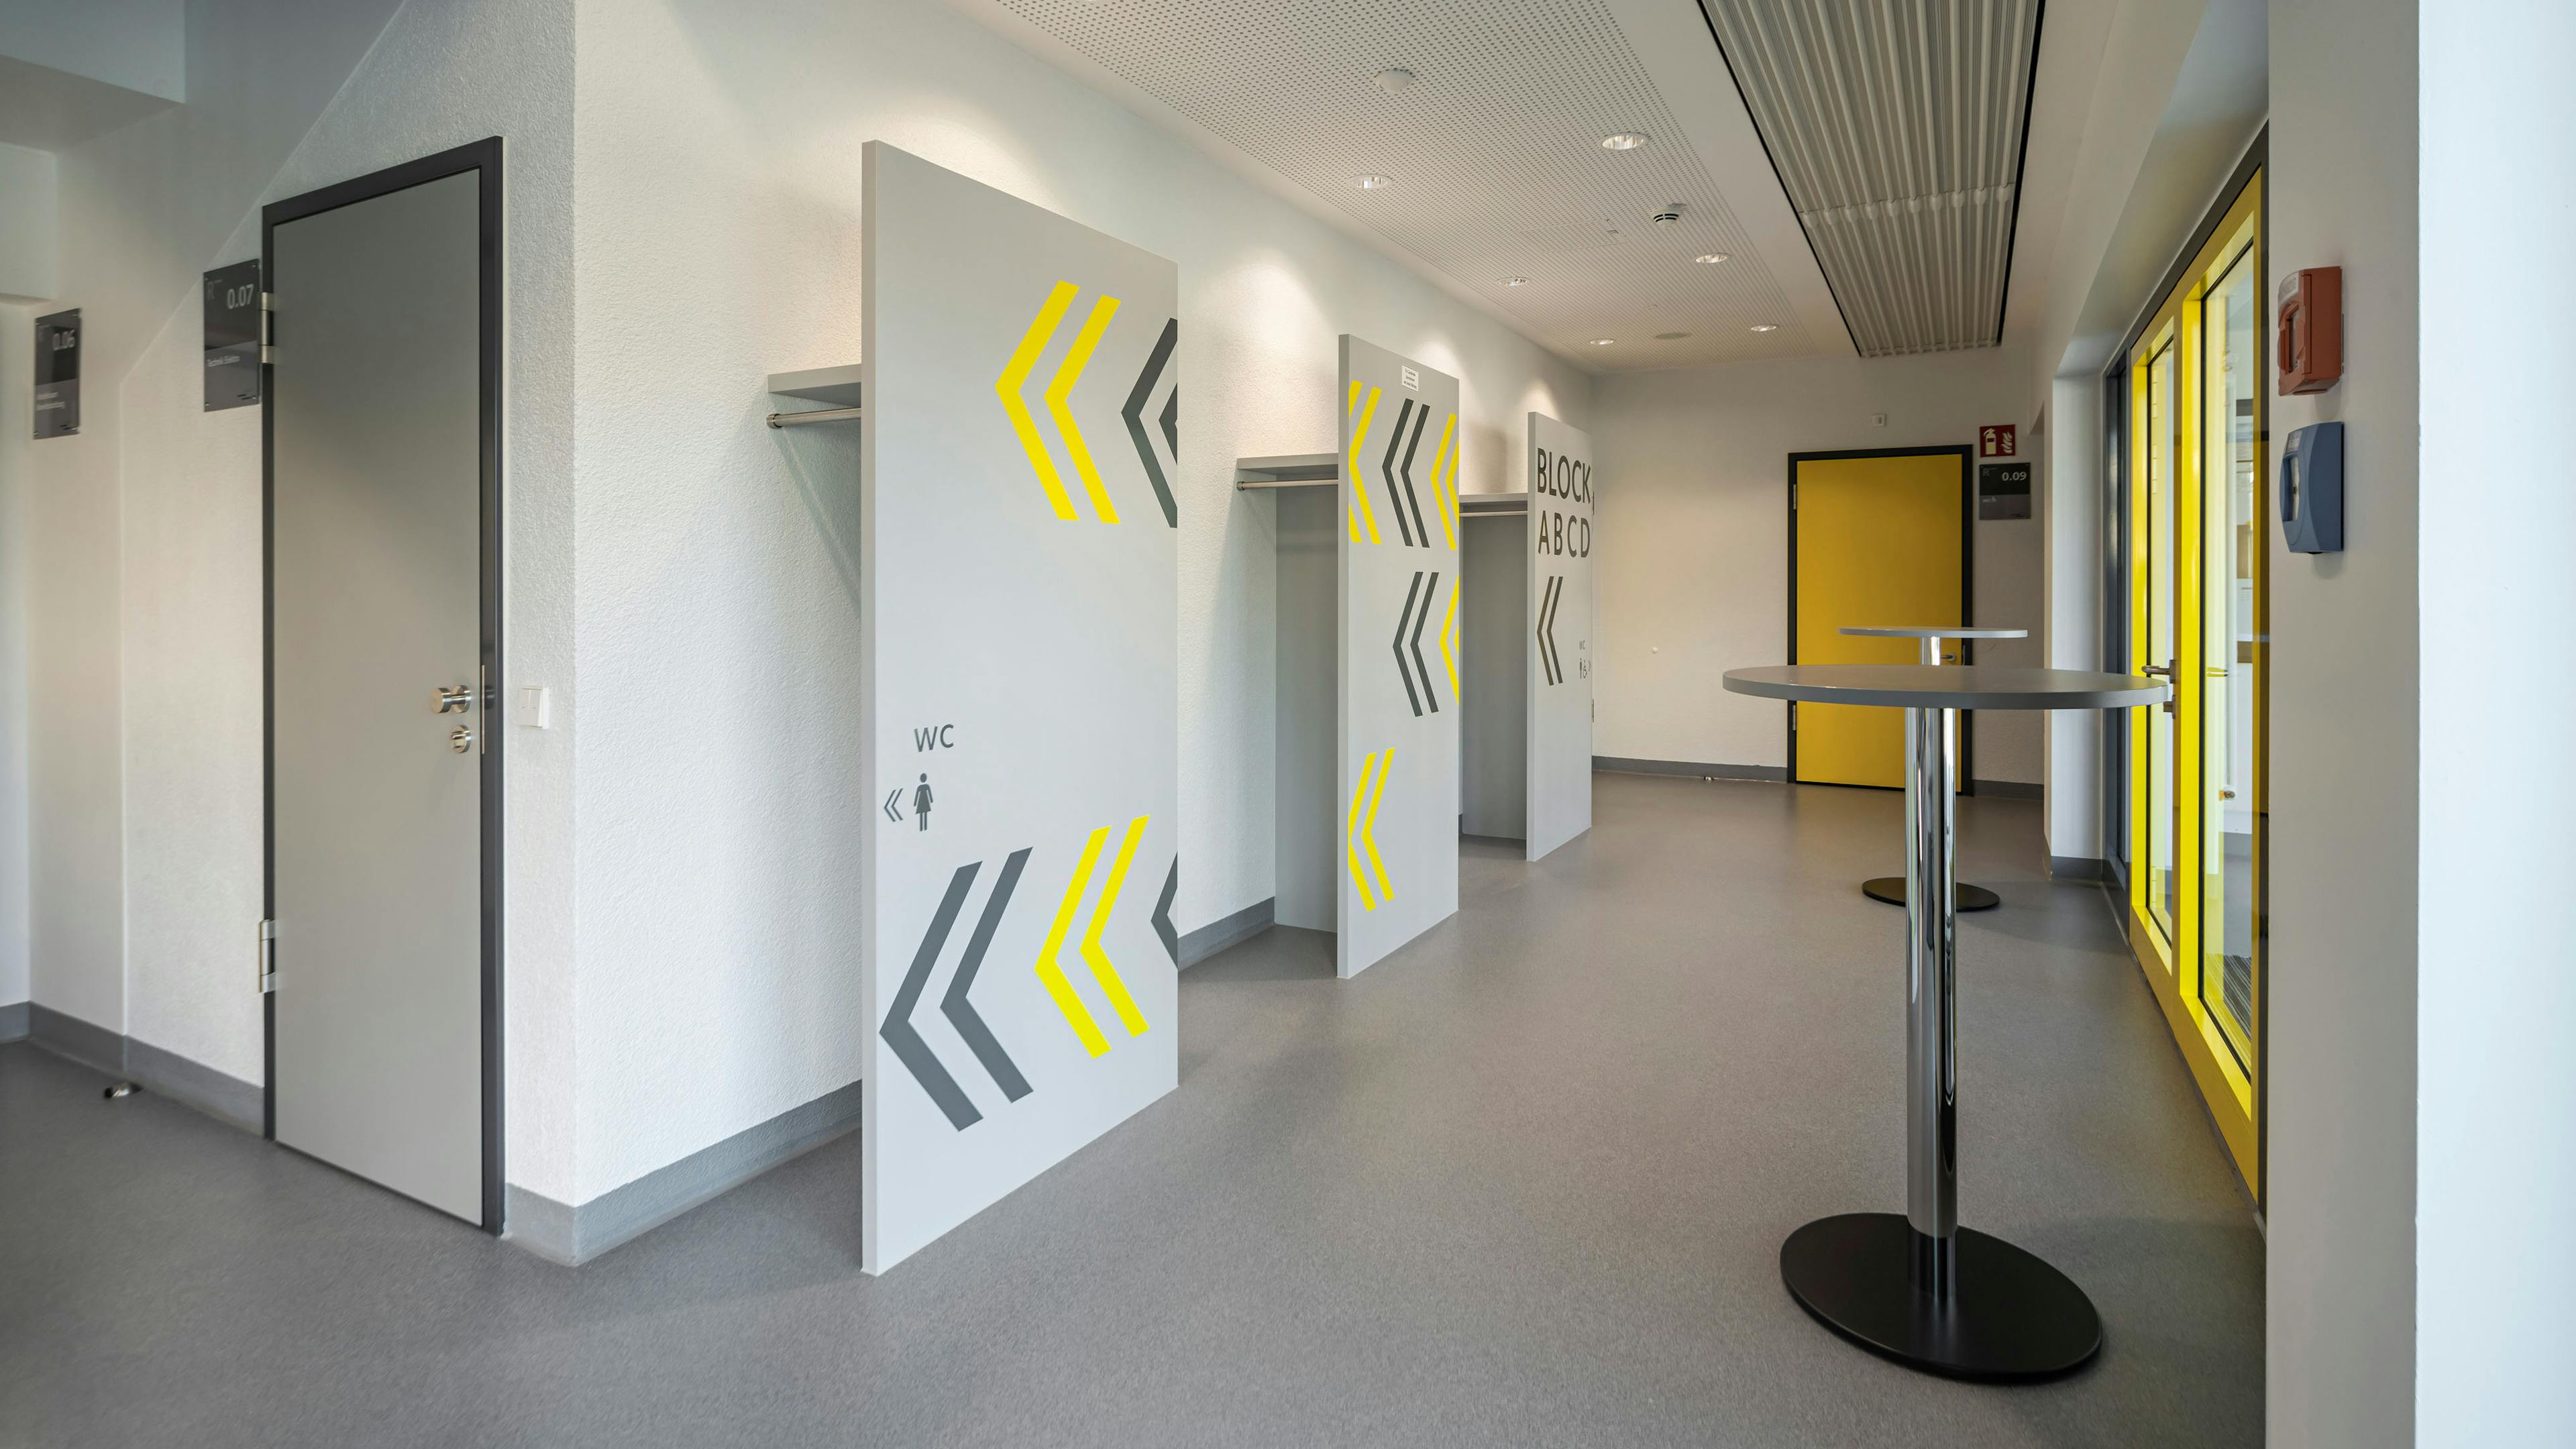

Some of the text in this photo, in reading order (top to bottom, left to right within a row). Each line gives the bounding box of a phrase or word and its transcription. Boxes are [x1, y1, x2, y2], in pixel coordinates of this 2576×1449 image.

[227, 284, 254, 309] 0.07
[1537, 447, 1592, 503] BLOCK
[2002, 471, 2027, 481] 0.09
[914, 724, 954, 753] WC
